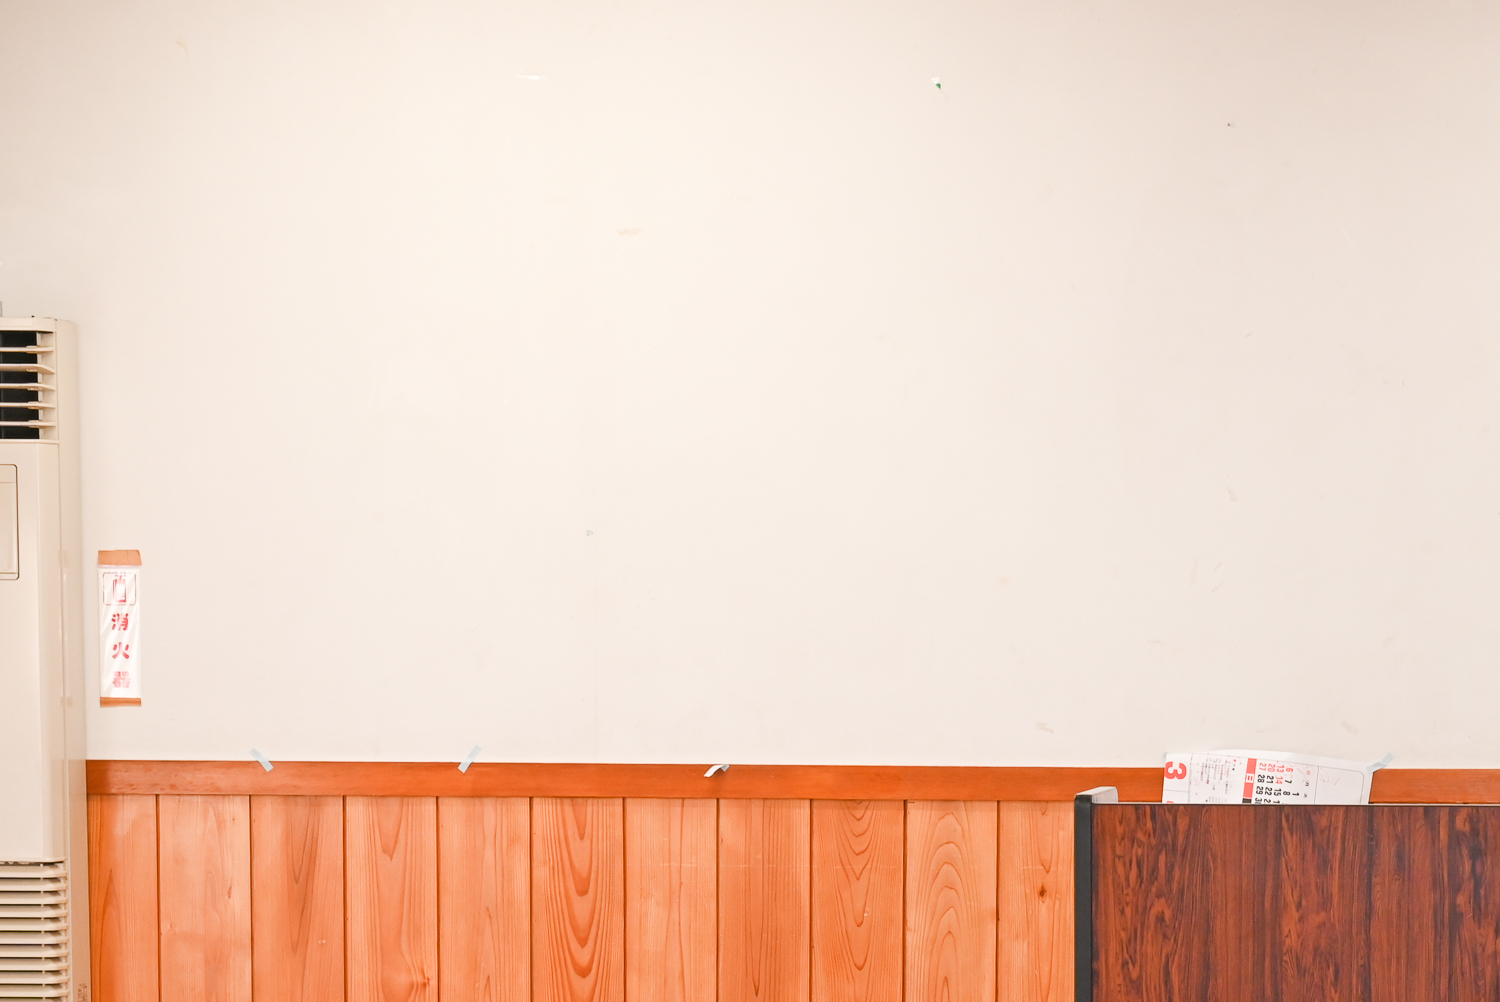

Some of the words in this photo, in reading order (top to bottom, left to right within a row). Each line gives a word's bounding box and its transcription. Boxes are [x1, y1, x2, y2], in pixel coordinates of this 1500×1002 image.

[111, 613, 130, 688] 消火器
[1164, 761, 1187, 780] 3
[1259, 762, 1267, 771] 27
[1267, 763, 1276, 772] 20
[1276, 765, 1285, 773] 13
[1257, 774, 1265, 783] 28
[1266, 775, 1274, 784] 21
[1275, 776, 1283, 784] 14
[1256, 786, 1264, 795] 29
[1264, 787, 1273, 796] 22
[1273, 788, 1282, 796] 15
